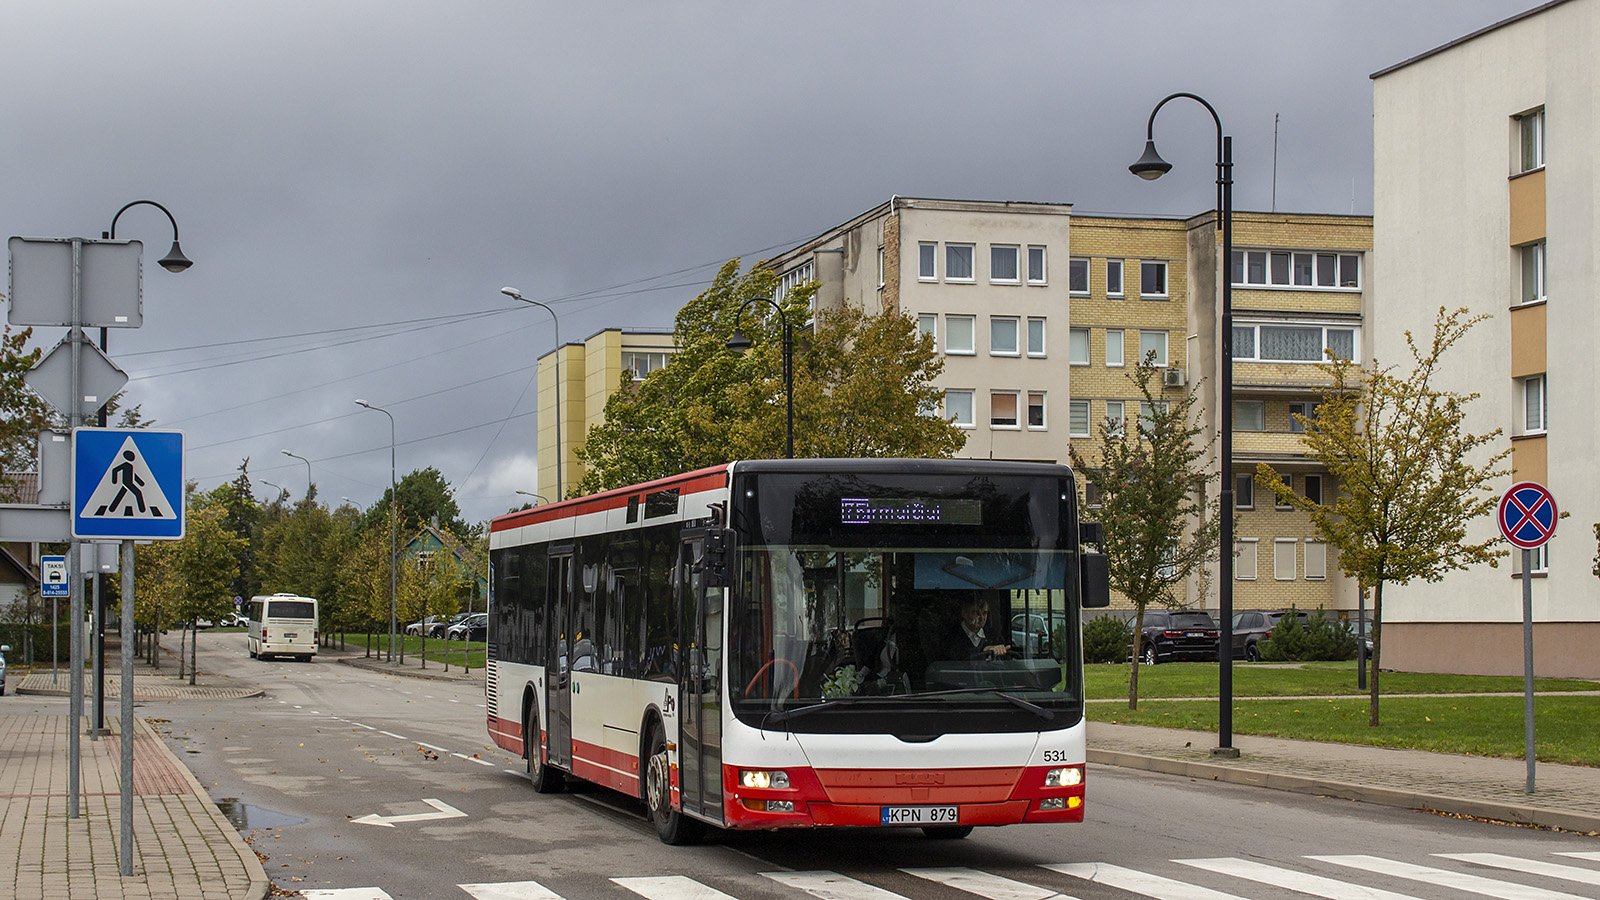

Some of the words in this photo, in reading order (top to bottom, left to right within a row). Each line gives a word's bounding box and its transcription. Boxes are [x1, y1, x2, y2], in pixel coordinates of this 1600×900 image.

[1043, 750, 1067, 762] 531
[890, 808, 921, 822] KPN
[930, 808, 956, 821] 879
